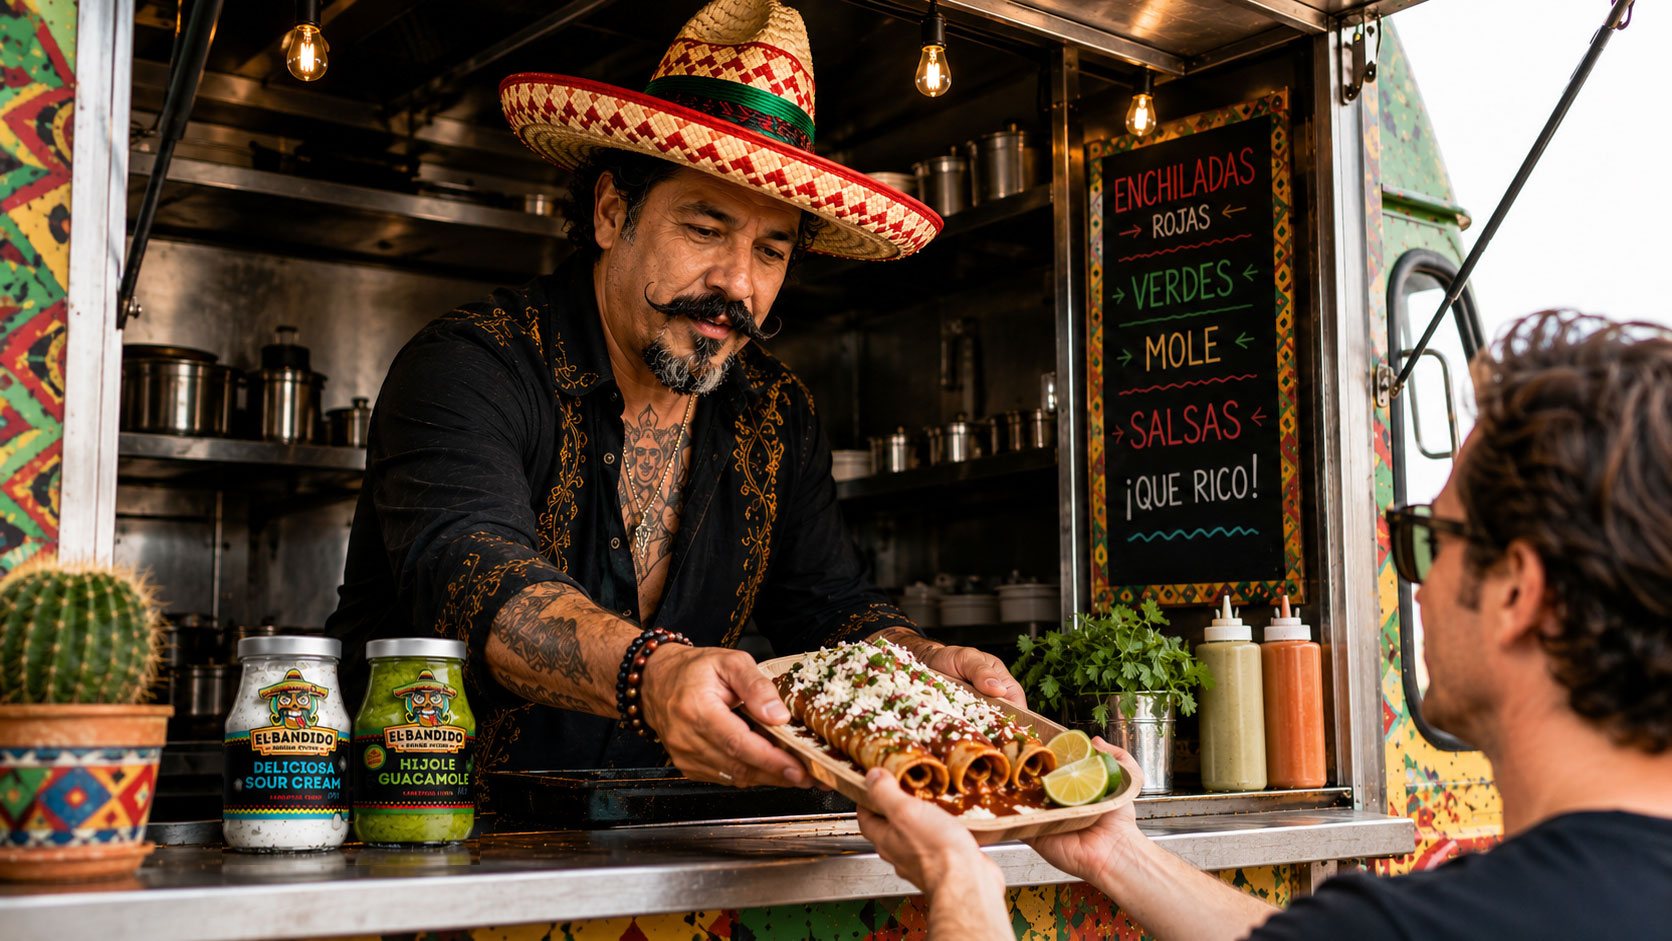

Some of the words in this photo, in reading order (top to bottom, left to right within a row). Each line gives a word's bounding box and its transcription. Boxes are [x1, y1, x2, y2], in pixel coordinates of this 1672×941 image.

[1114, 147, 1256, 213] ENCHILADAS
[1152, 204, 1211, 239] ROJAS
[1131, 260, 1234, 310] VERDES
[1145, 325, 1221, 372] MOLE
[1130, 400, 1241, 450] SALSAS
[1125, 472, 1182, 520] ¡QUE
[1193, 453, 1259, 504] RICO!
[245, 776, 288, 789] SOUR
[292, 776, 341, 789] CREAM
[254, 761, 335, 775] DELICIOSA
[378, 772, 469, 785] GUACAMOLE
[400, 758, 456, 771] HIJOLE
